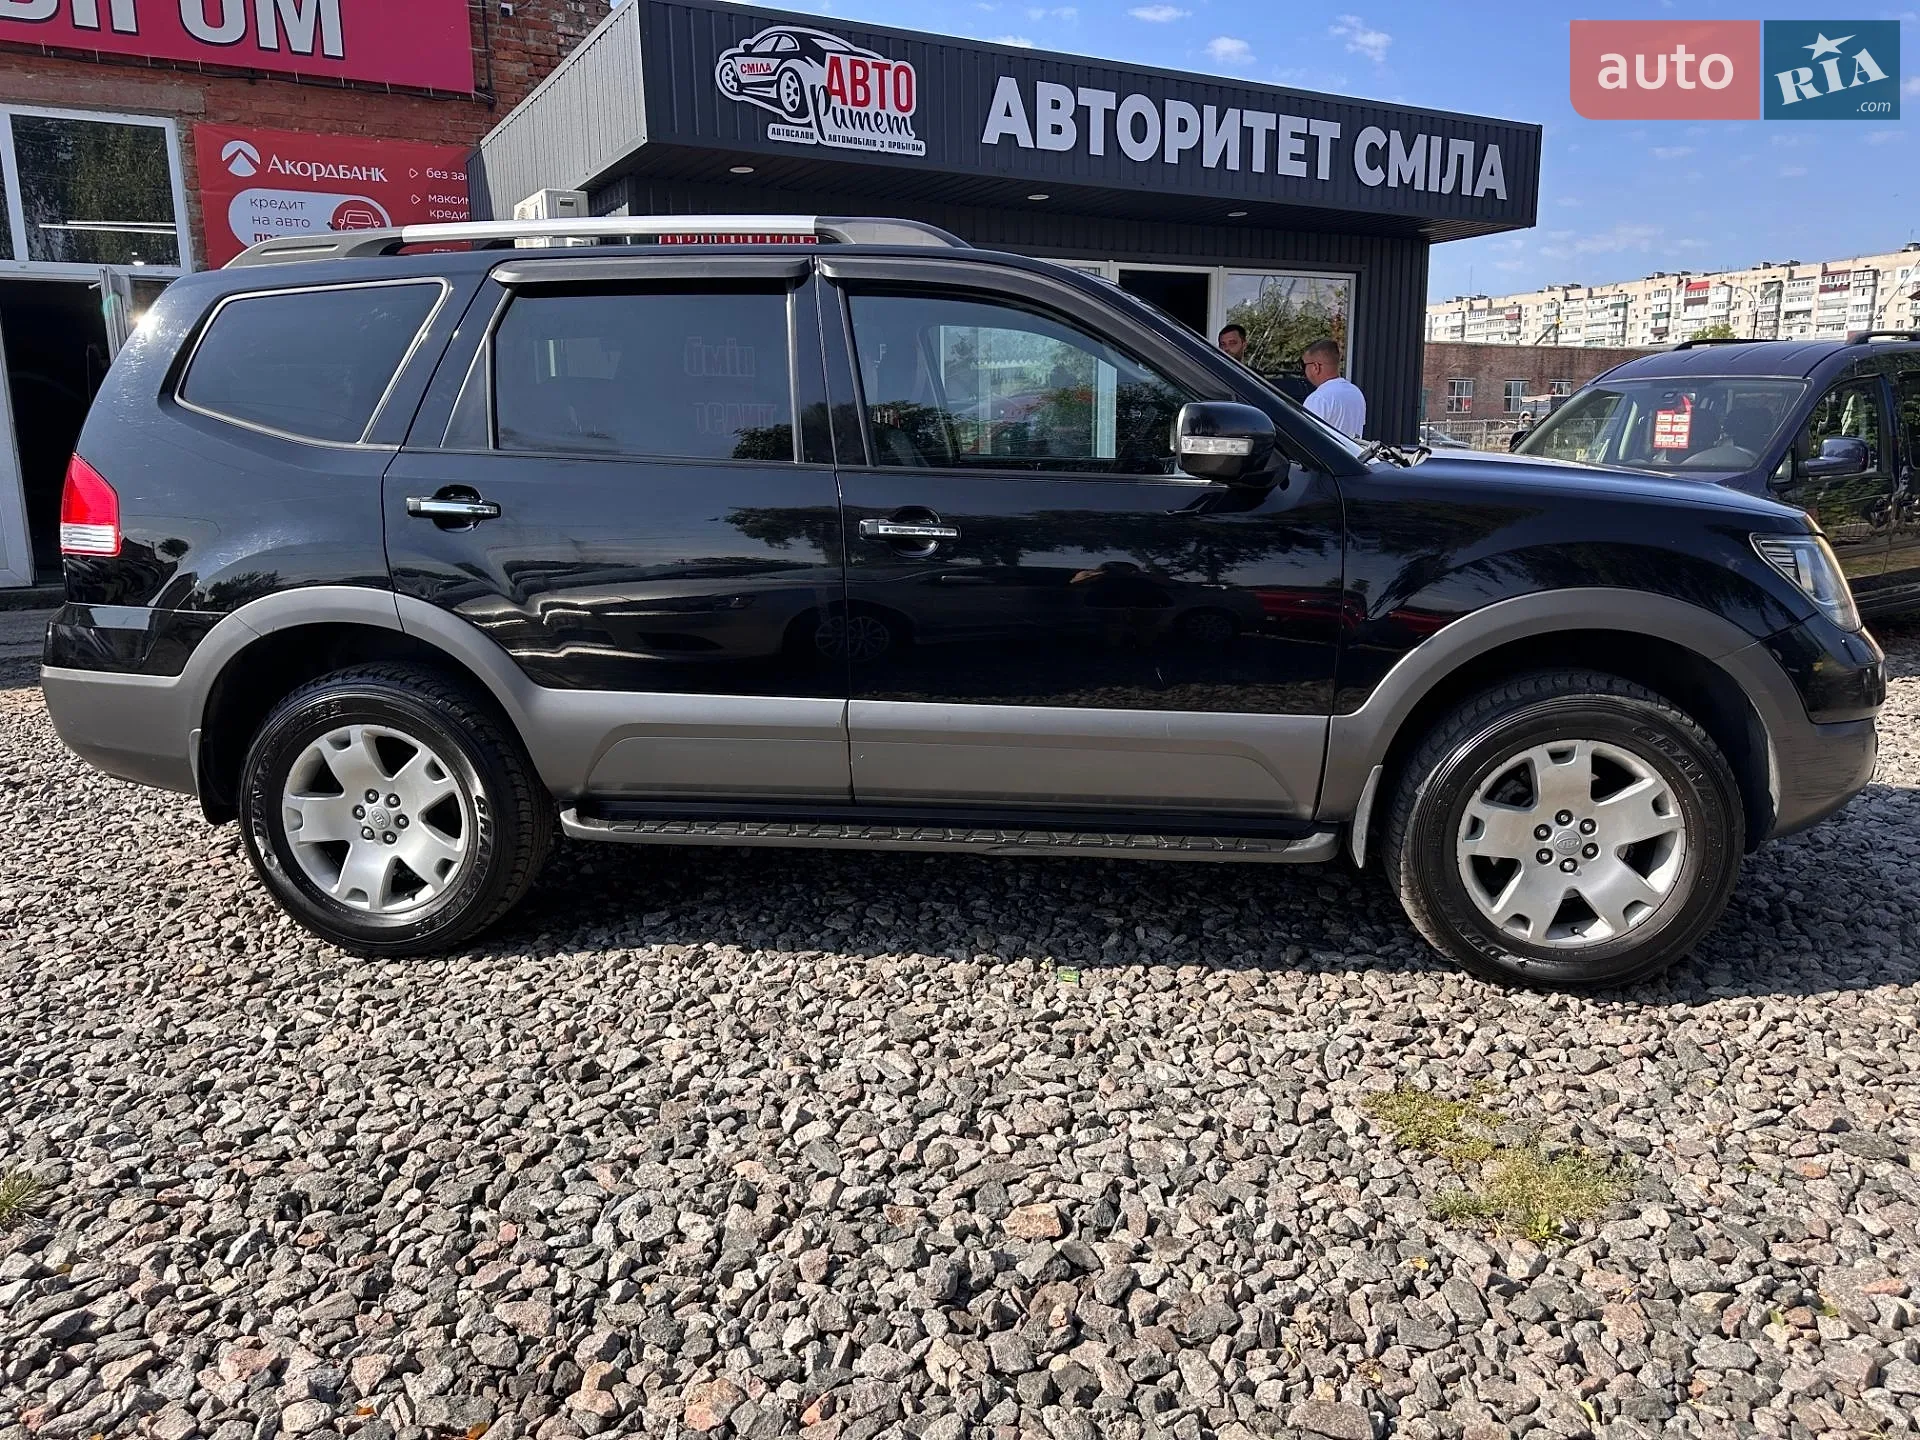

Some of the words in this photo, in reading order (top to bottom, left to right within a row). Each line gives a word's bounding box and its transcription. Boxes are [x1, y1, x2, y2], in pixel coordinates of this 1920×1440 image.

[740, 62, 772, 75] СМІЛА
[827, 55, 913, 113] АВТО
[771, 127, 815, 140] АВТОСАЛОН
[981, 75, 1341, 180] АВТОРИТЕТ
[1353, 125, 1508, 200] СМІЛА
[426, 167, 448, 180] без
[249, 198, 307, 211] кредит
[252, 215, 272, 226] на
[275, 216, 311, 228] авто
